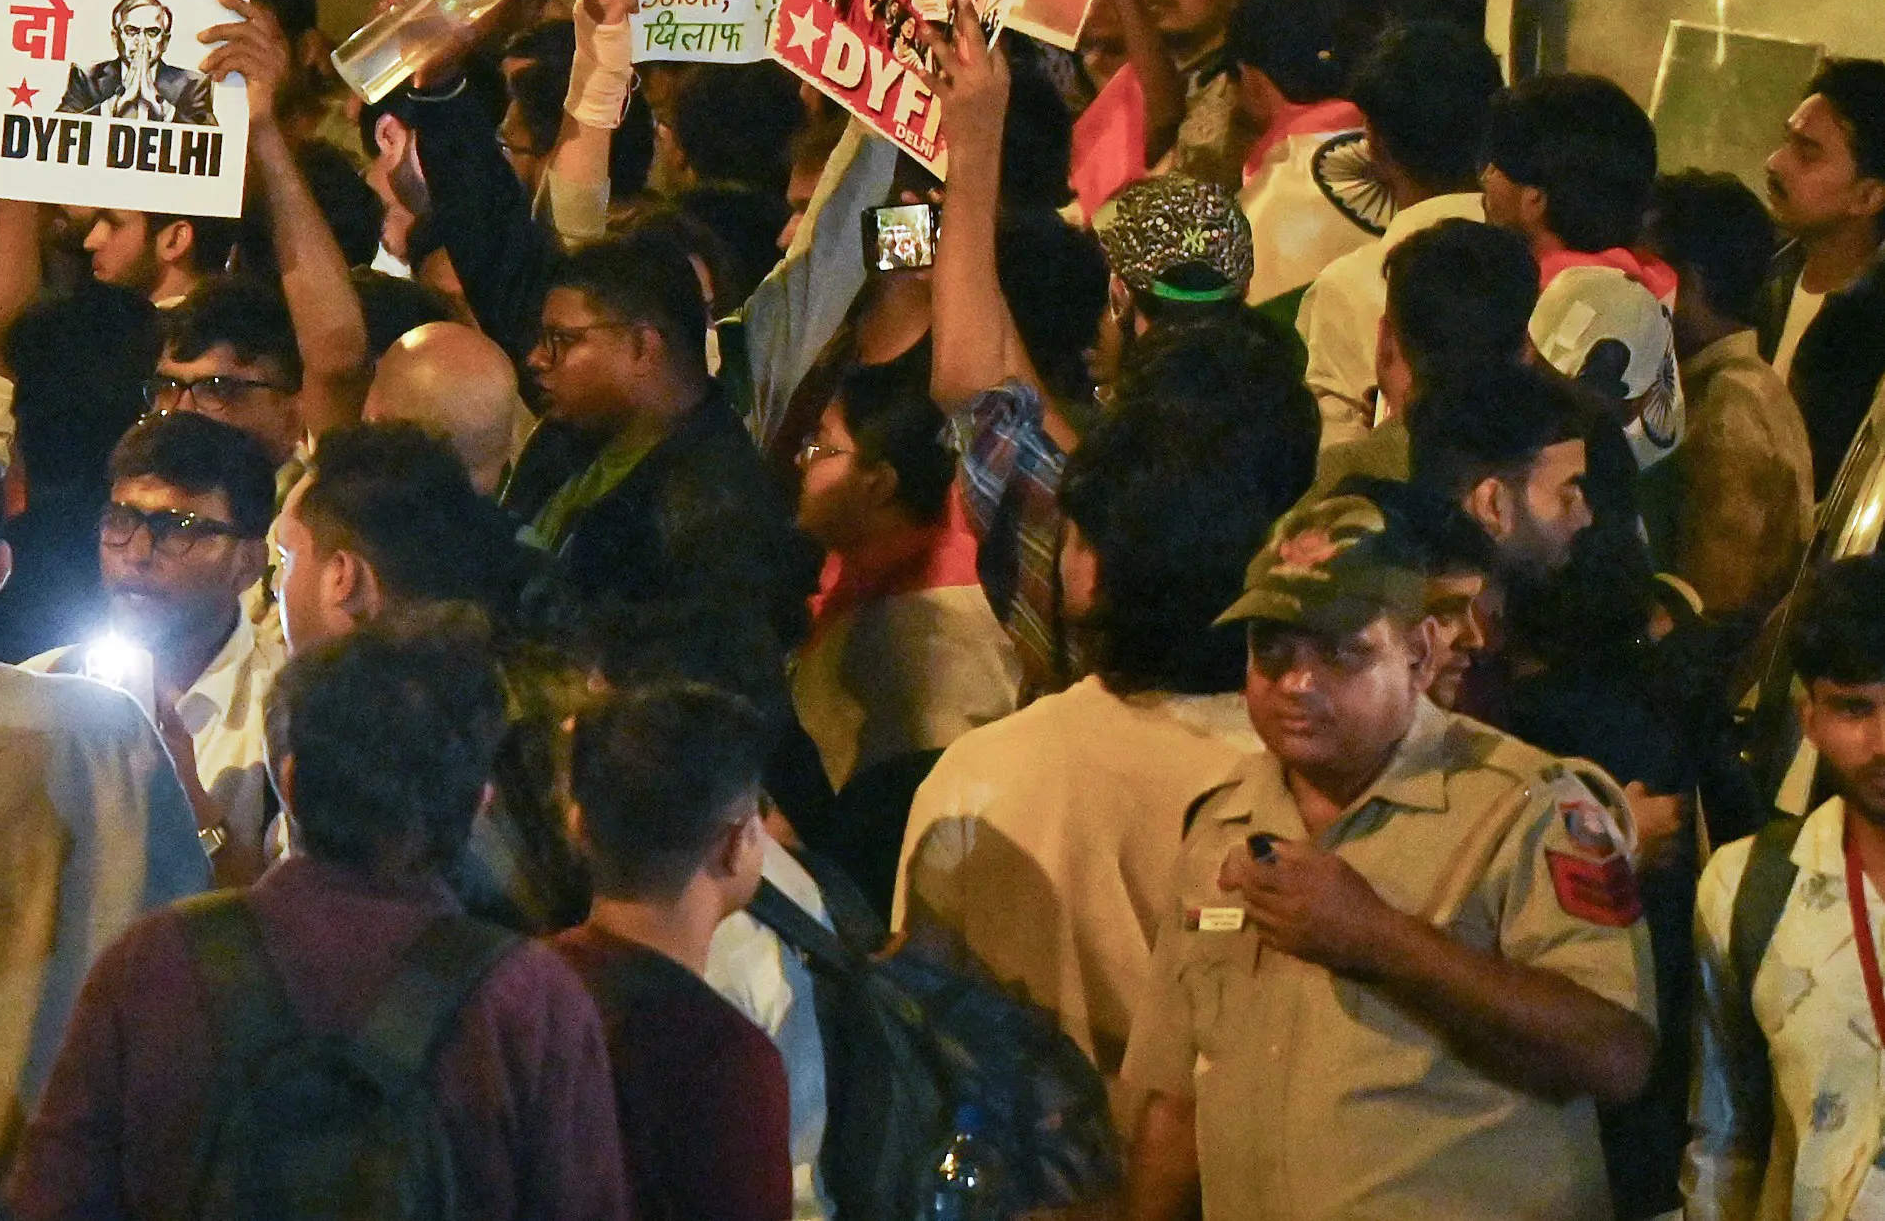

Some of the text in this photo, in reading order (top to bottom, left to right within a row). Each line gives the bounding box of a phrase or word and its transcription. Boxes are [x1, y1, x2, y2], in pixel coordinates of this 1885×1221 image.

[820, 20, 943, 144] DYFI
[1, 113, 223, 177] DYFI DELHI
[894, 123, 936, 159] DELHI
